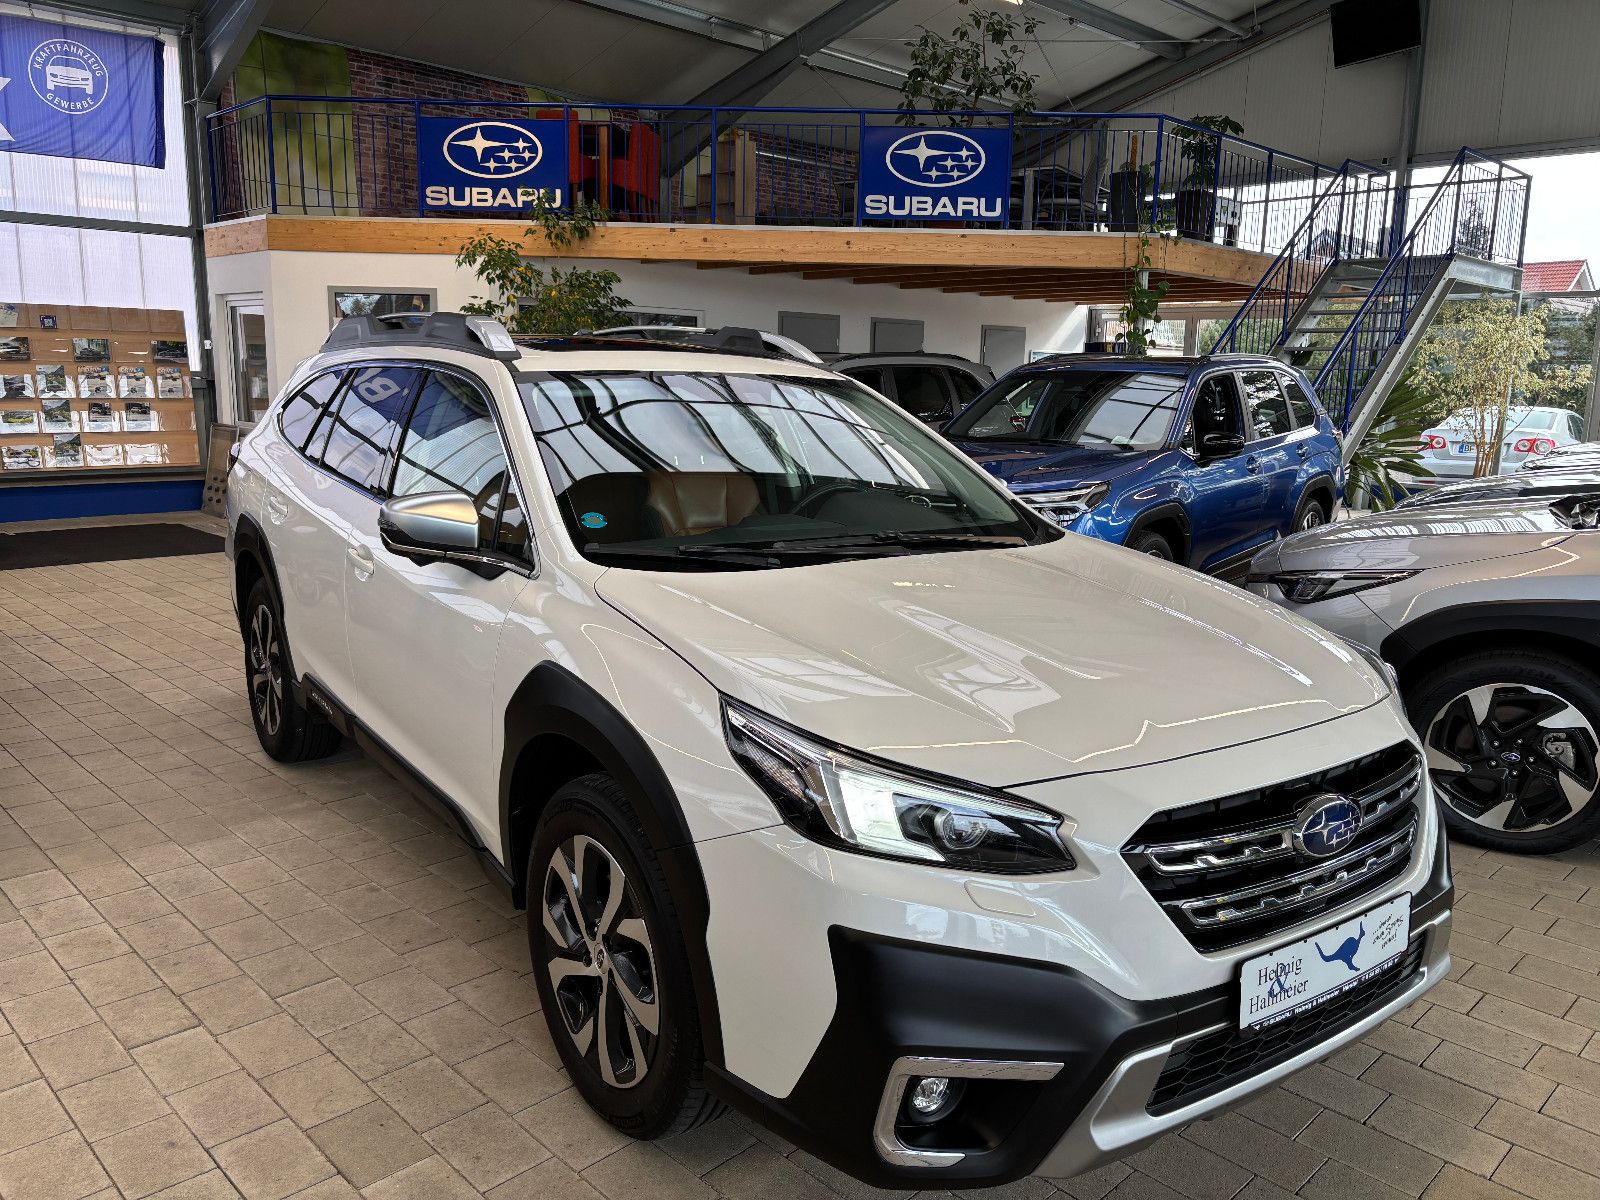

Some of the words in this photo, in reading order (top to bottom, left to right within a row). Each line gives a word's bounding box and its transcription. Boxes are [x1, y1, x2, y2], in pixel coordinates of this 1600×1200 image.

[33, 43, 103, 77] KRAFTFAHRZEUG
[46, 92, 95, 110] GEWERBE
[425, 186, 562, 209] SUBARU
[864, 194, 1002, 217] SUBARU
[1257, 956, 1303, 986] Helmig
